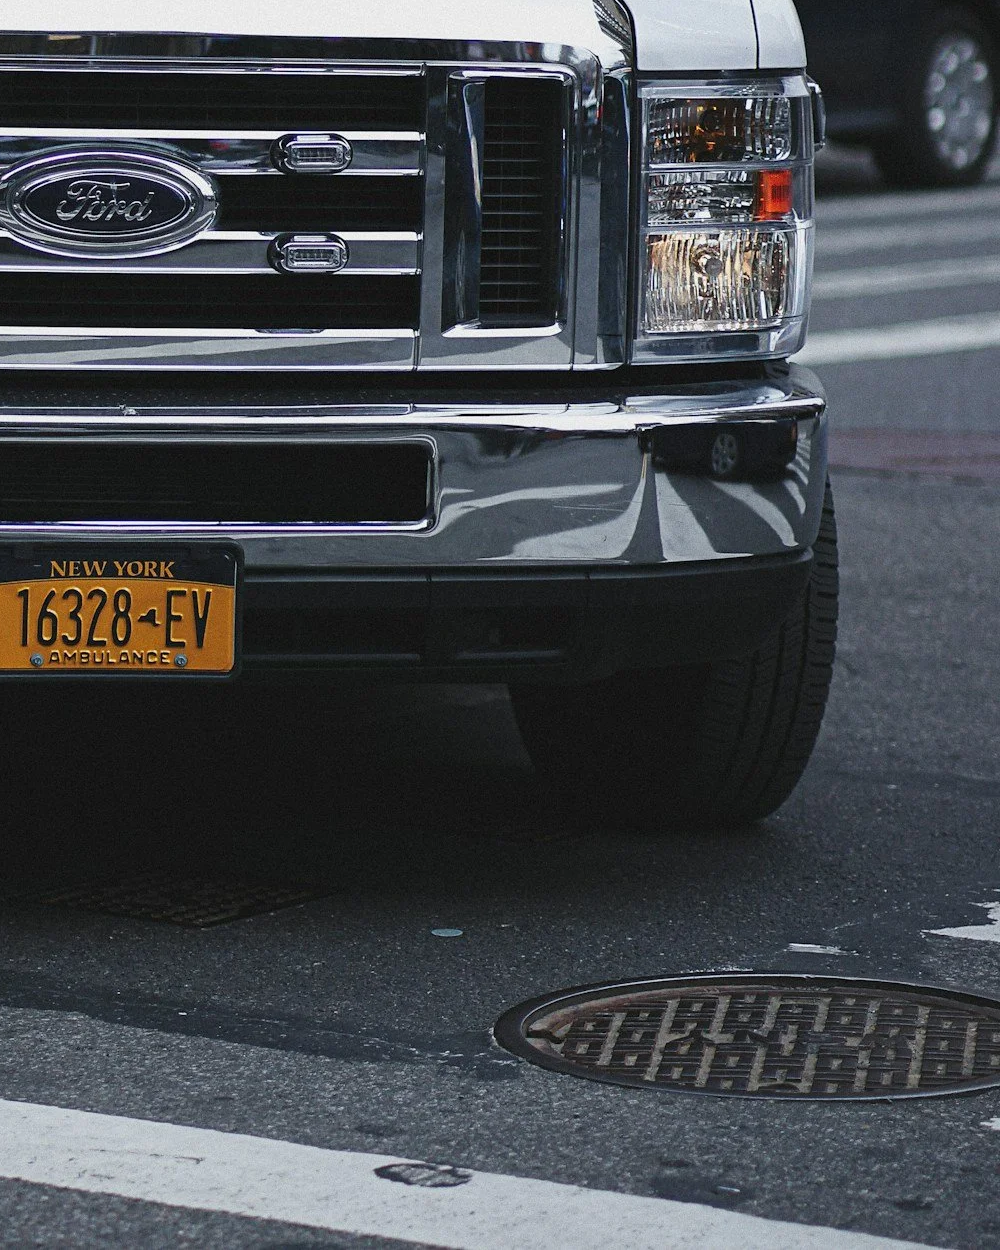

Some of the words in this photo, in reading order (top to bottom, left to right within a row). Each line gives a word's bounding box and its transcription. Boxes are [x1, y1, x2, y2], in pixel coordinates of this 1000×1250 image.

[55, 179, 155, 222] Ford
[50, 560, 108, 578] NEW
[113, 560, 176, 579] YORK
[49, 650, 172, 665] AMBULANCE
